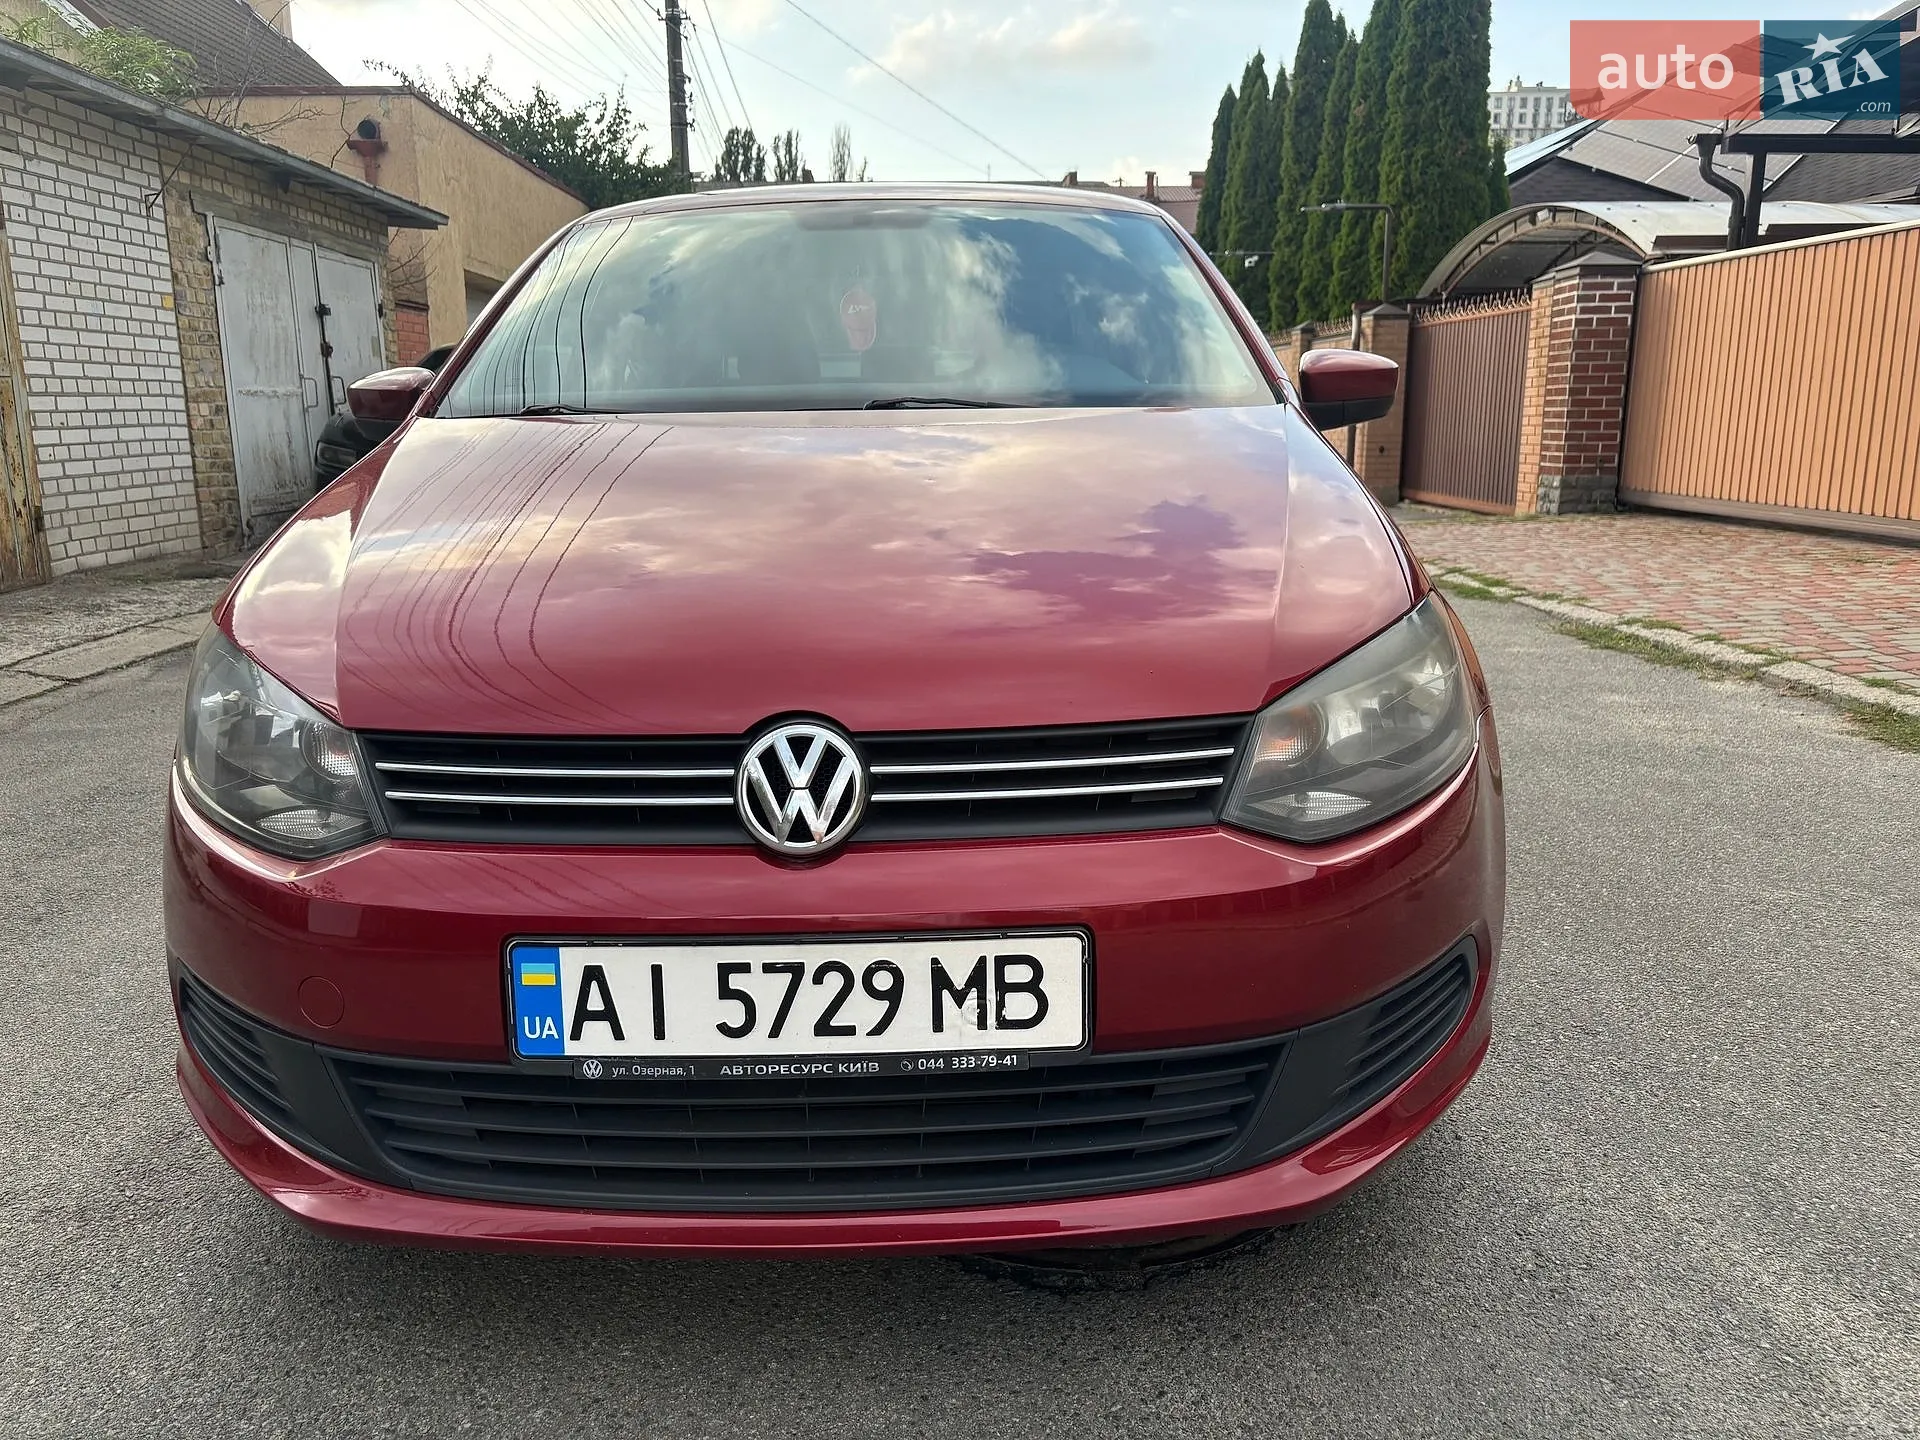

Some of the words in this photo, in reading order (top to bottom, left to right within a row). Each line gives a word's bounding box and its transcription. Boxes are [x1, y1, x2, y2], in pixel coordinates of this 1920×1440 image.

[569, 963, 666, 1041] AI
[715, 959, 905, 1039] 5729
[930, 954, 1050, 1033] MB
[523, 1015, 559, 1039] UA
[612, 1066, 629, 1078] ул.
[632, 1065, 687, 1078] Озерная,
[689, 1065, 695, 1075] 1
[720, 1063, 834, 1076] АВТОРЕСУРС
[838, 1060, 880, 1074] КИЇВ
[918, 1058, 945, 1070] 044
[951, 1054, 1018, 1069] 333-79-41
